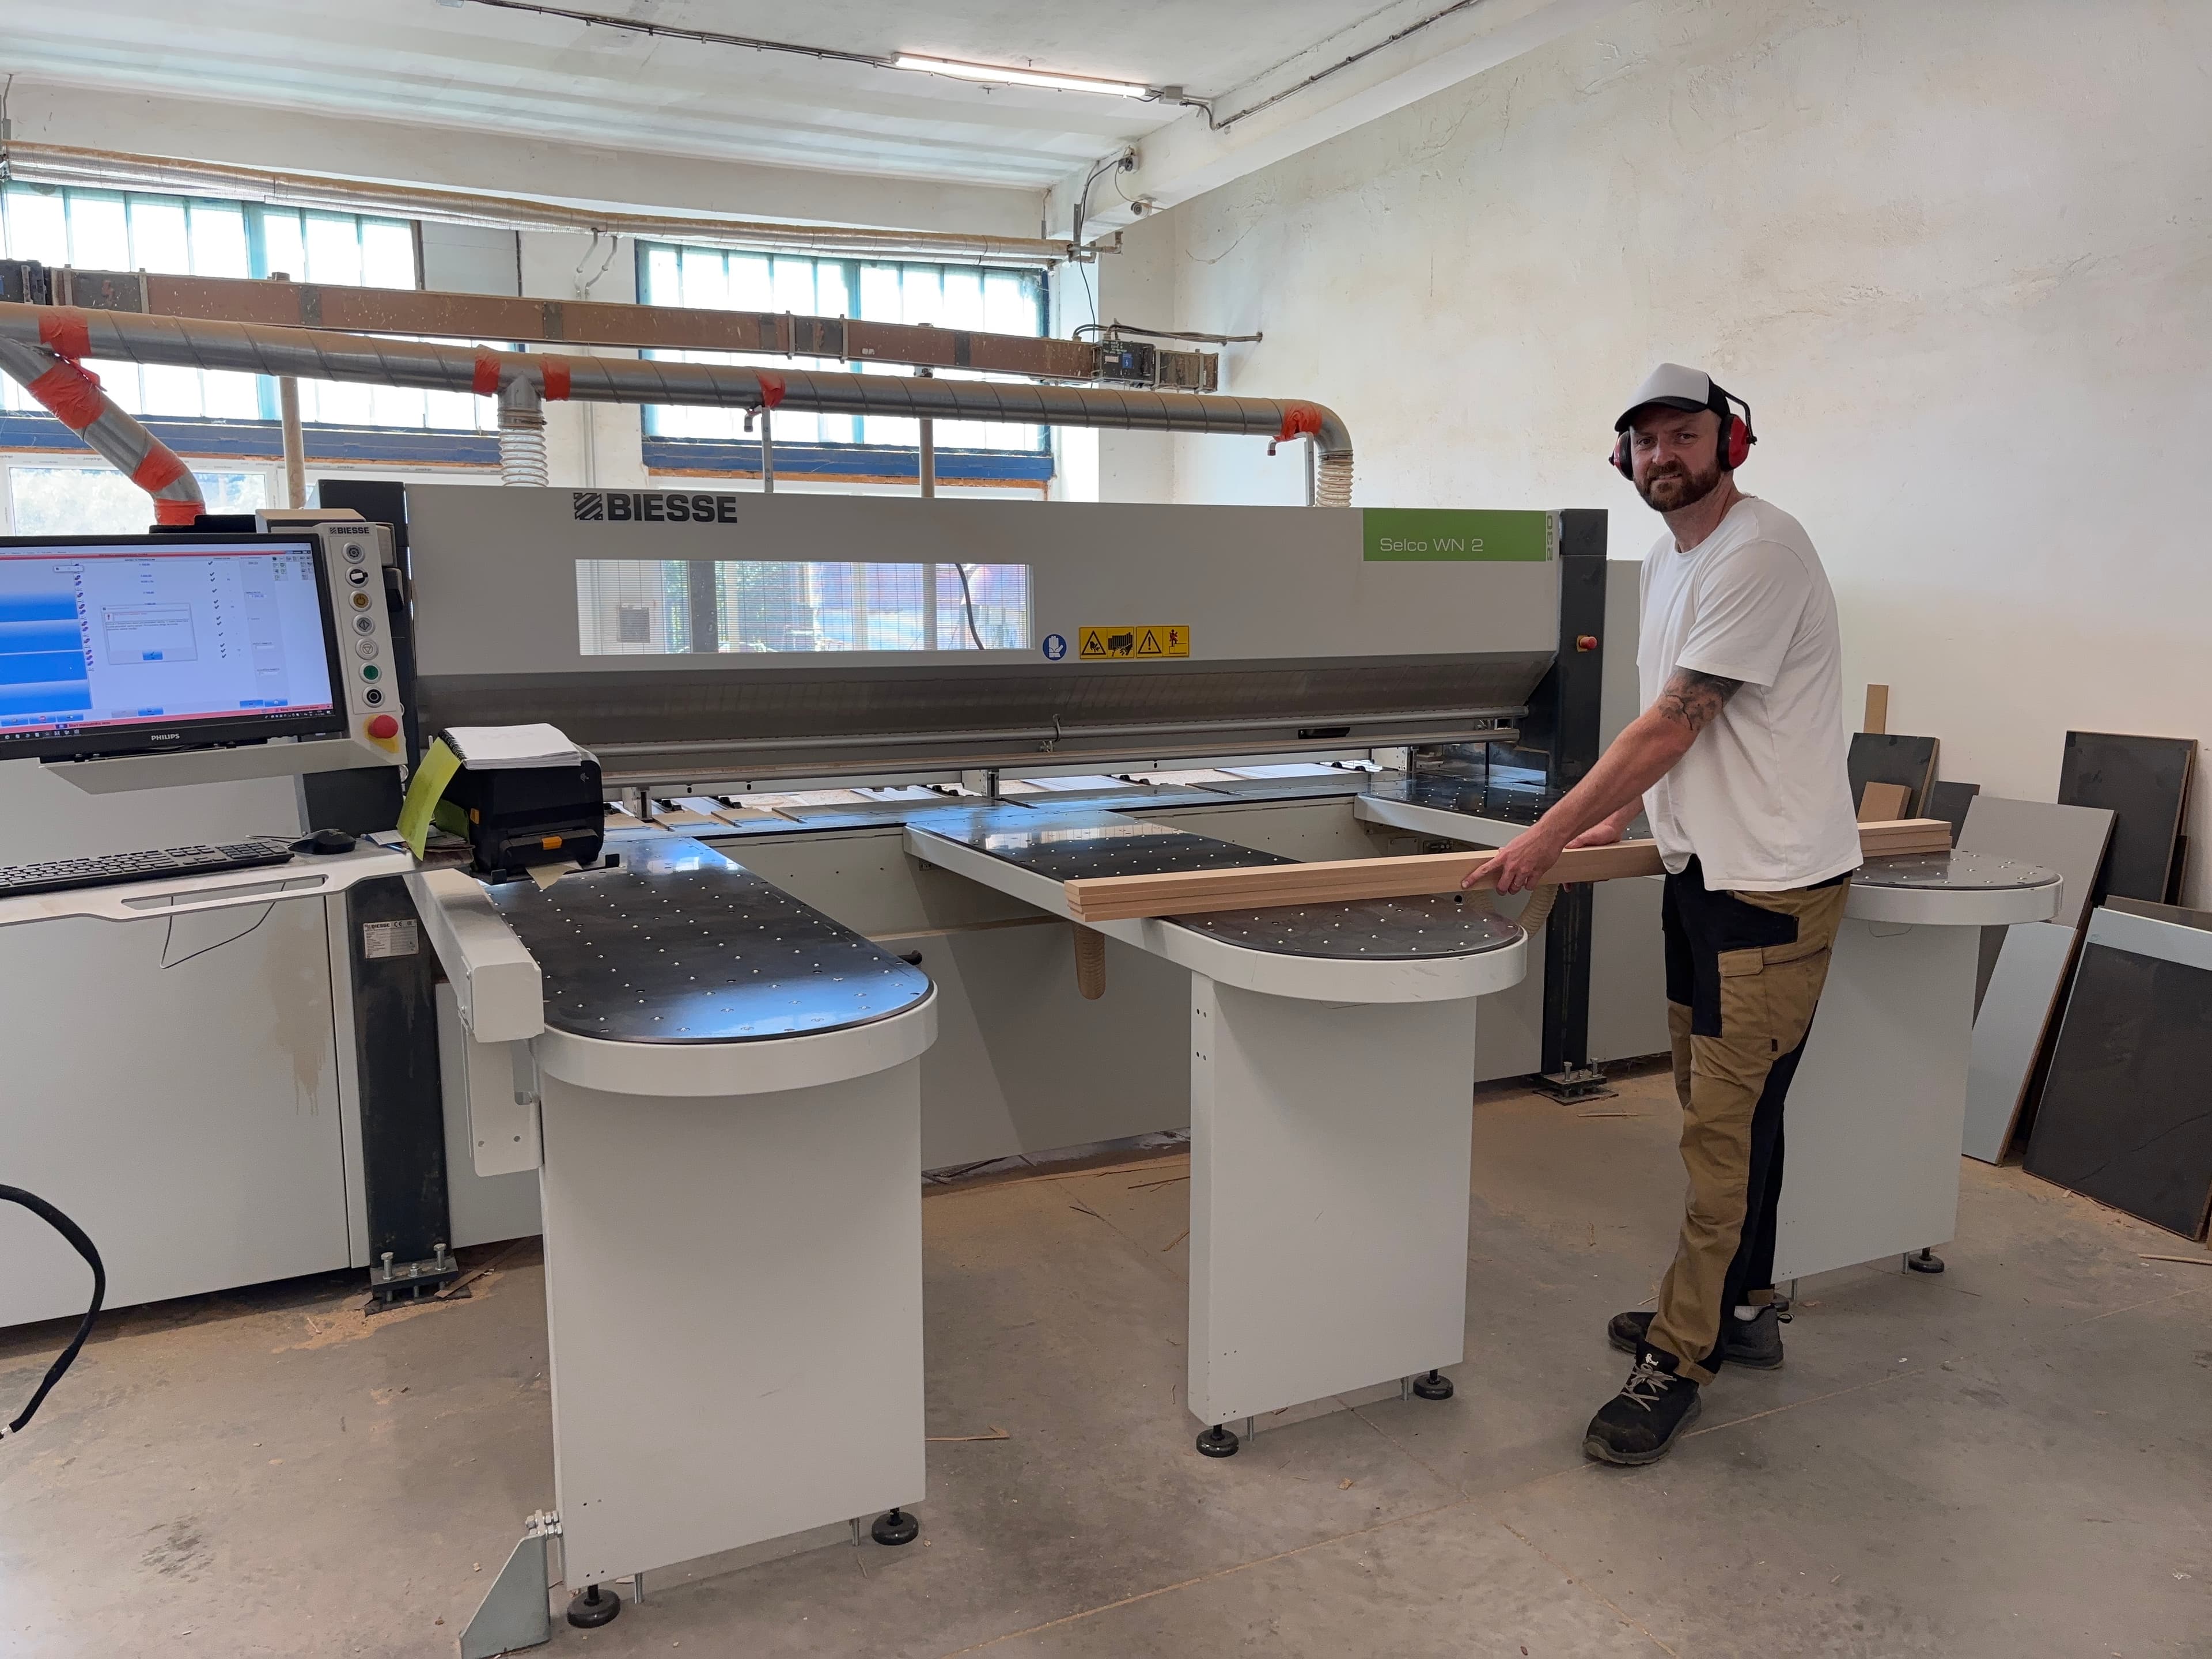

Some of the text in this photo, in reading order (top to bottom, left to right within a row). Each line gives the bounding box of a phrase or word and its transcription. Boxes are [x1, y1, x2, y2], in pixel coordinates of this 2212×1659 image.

[607, 493, 738, 524] BIESSE
[1380, 537, 1483, 552] Selco WN 2
